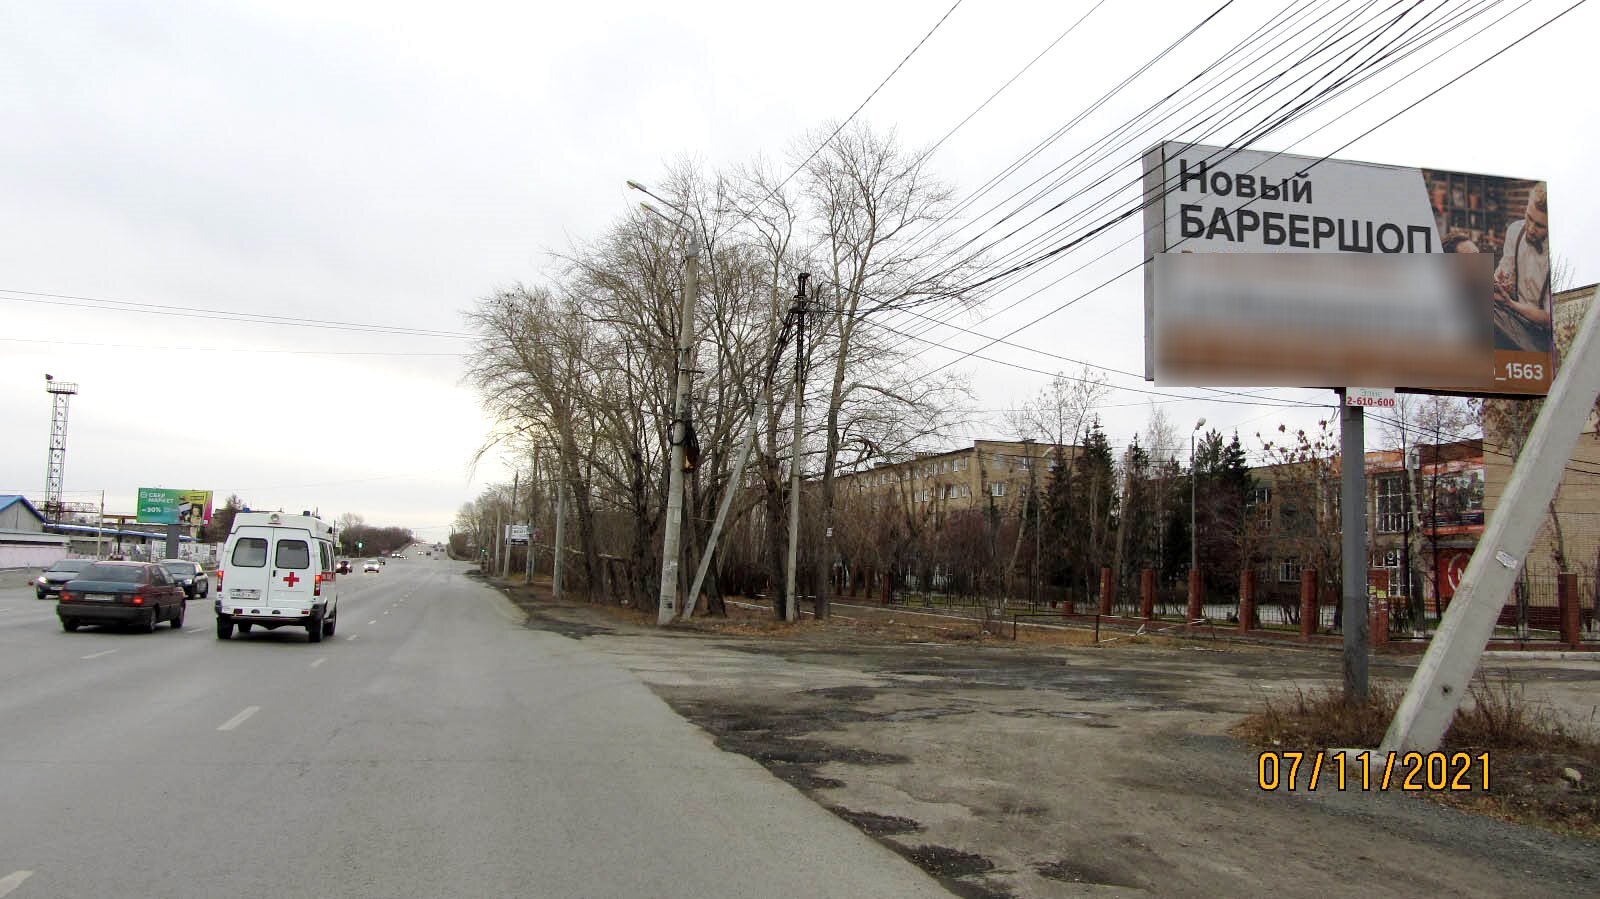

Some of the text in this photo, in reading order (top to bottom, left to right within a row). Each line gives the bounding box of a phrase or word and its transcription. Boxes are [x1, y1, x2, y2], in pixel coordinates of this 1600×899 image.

[1180, 158, 1312, 204] Новый
[1180, 203, 1432, 253] БАРБЕРШОП
[1493, 362, 1544, 381] _1563
[1346, 396, 1395, 407] 2-610-600
